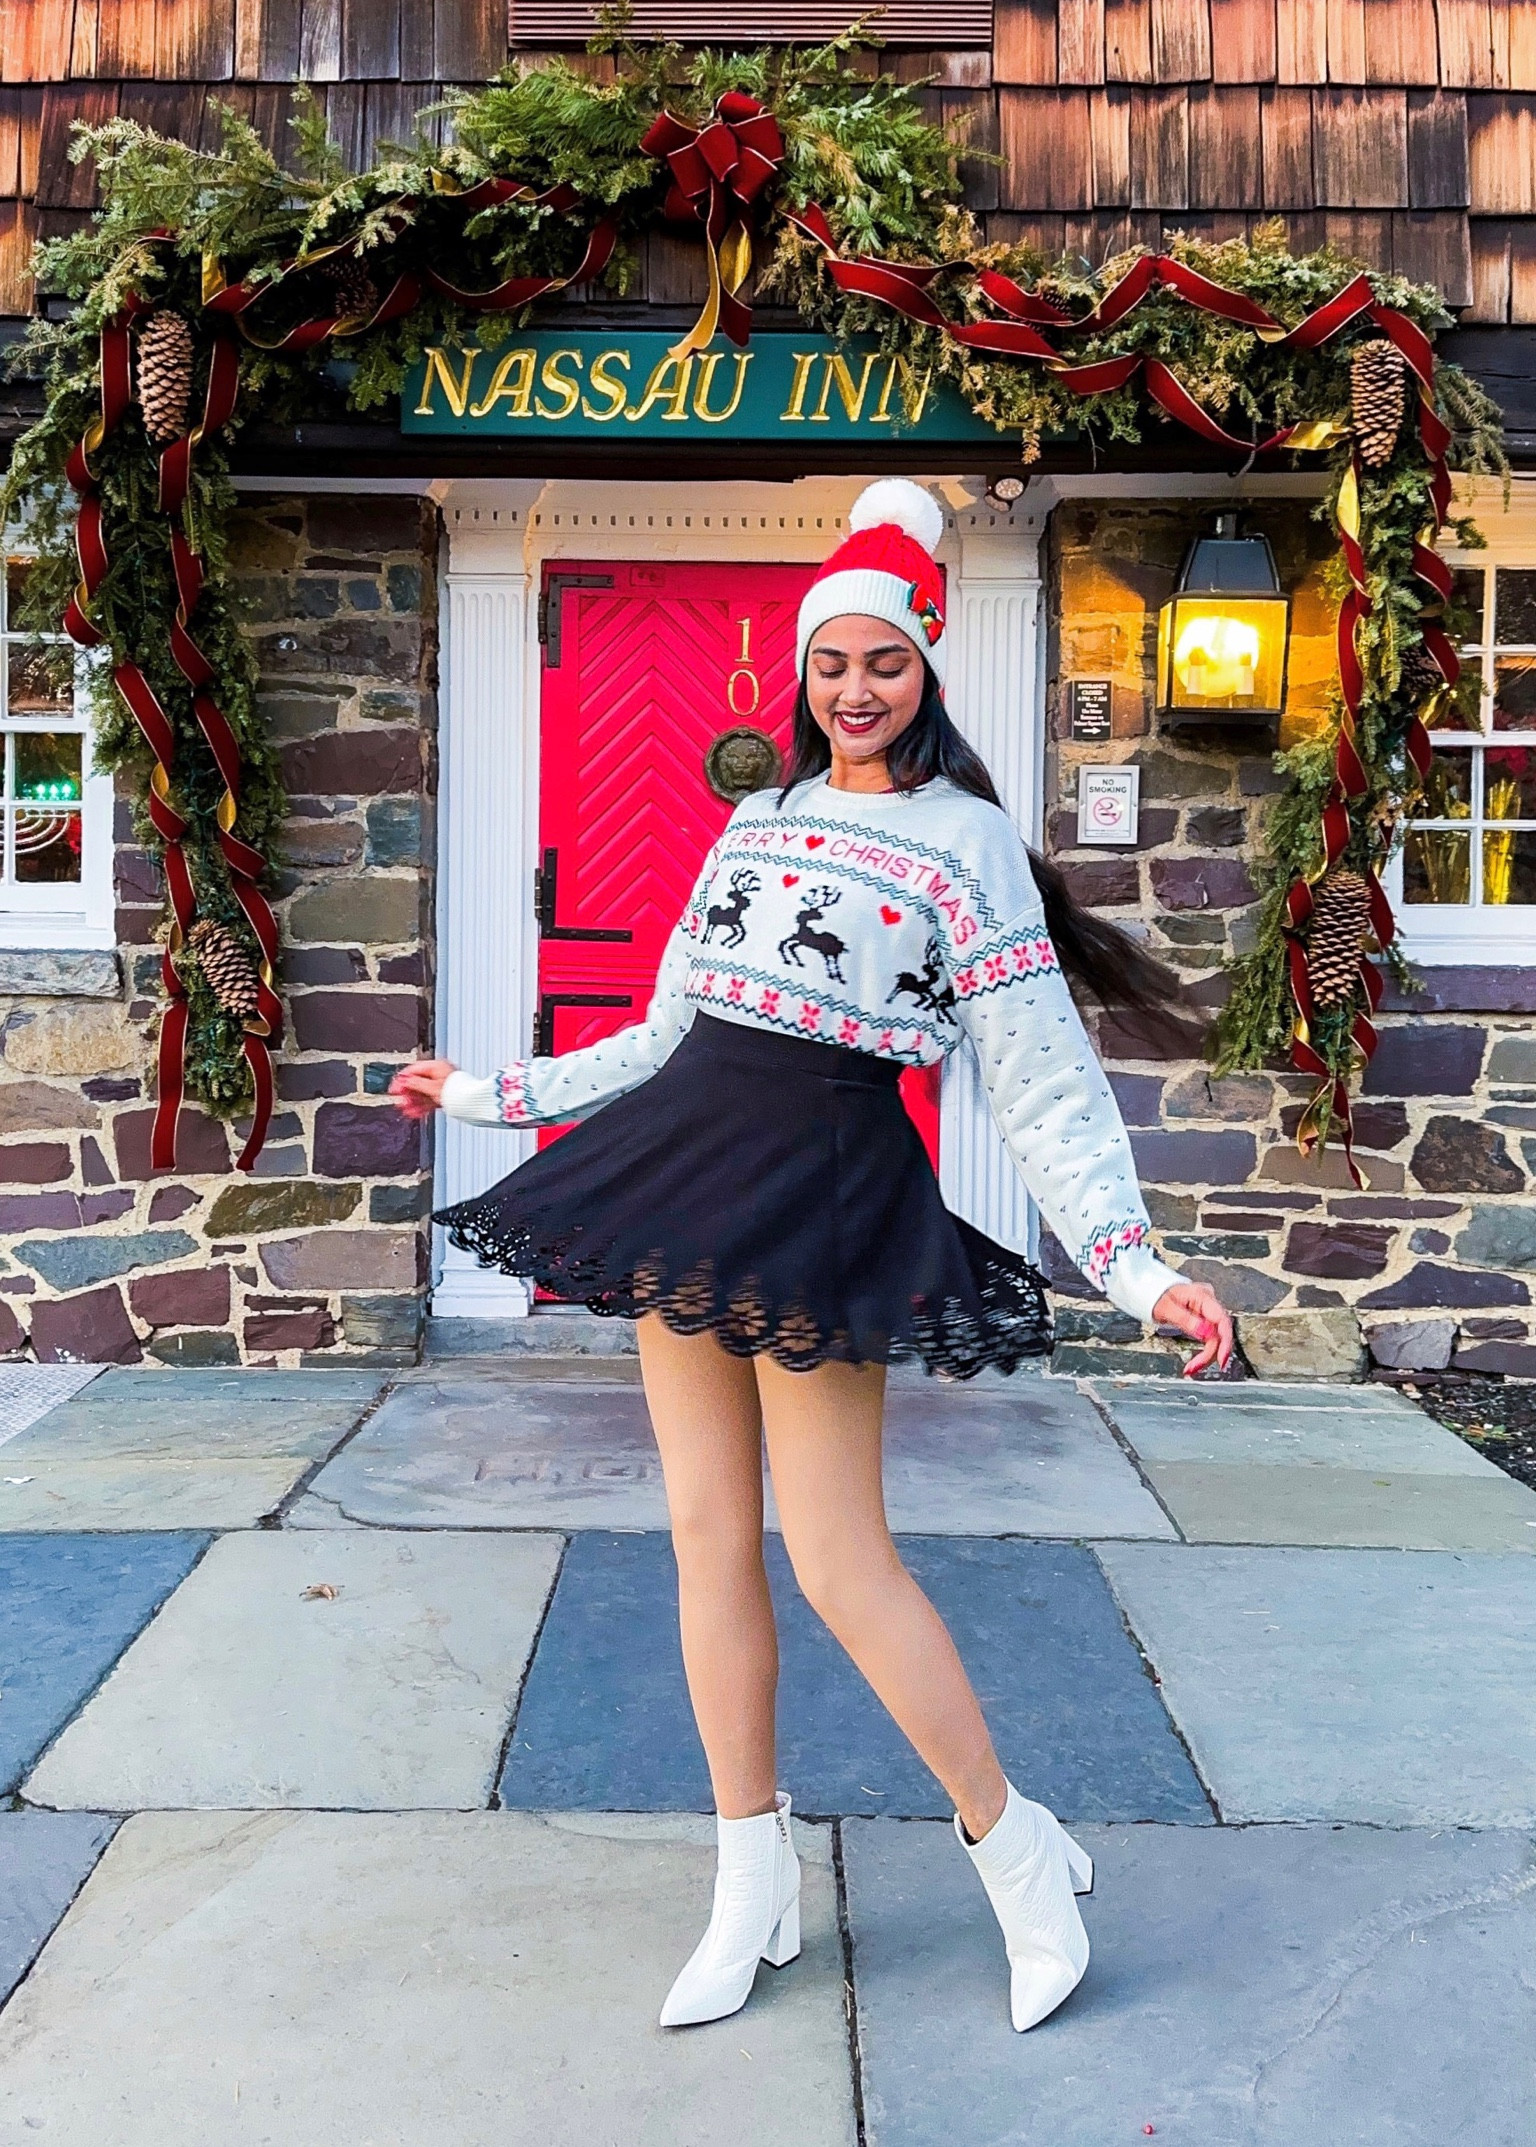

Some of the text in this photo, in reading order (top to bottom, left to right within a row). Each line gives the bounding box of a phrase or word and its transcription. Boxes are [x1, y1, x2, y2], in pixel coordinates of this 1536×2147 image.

[413, 346, 934, 424] NASSAU INN
[727, 617, 760, 717] 10
[829, 839, 978, 945] CHRISTMAS
